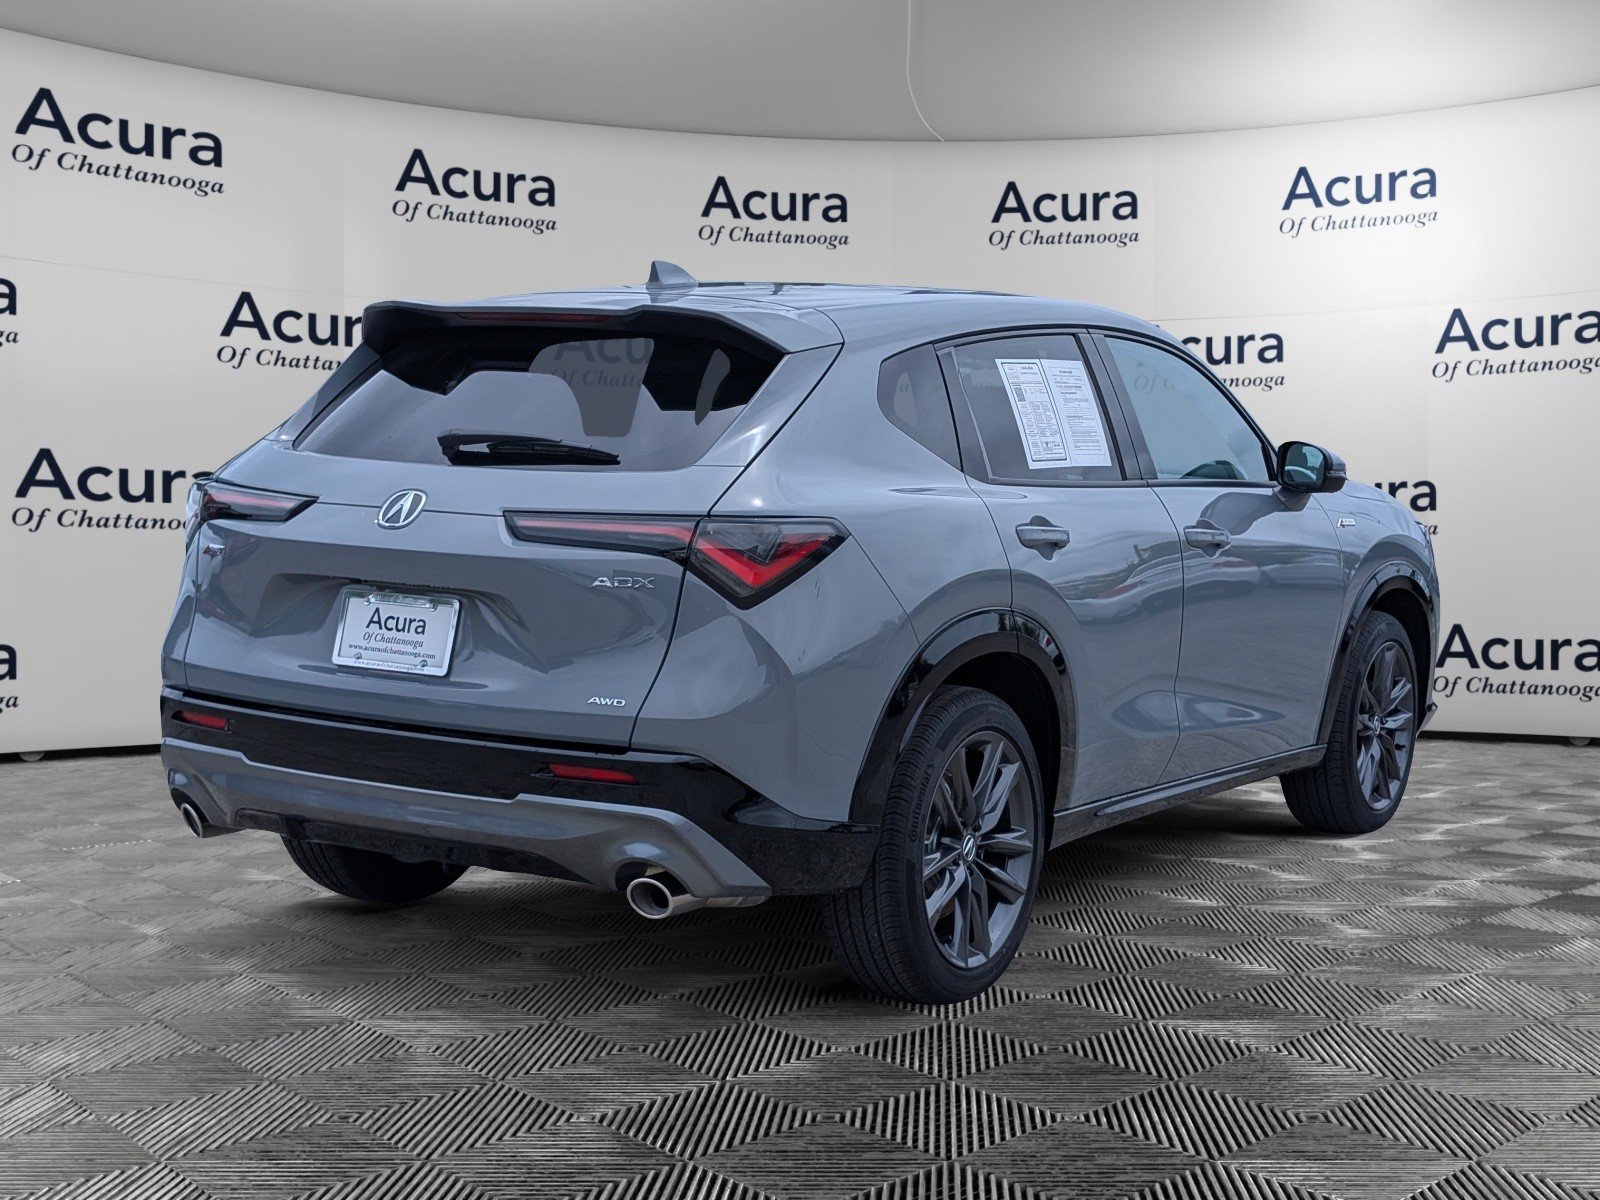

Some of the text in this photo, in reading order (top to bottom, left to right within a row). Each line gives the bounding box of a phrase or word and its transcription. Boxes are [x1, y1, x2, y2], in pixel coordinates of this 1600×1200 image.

[15, 87, 222, 168] Acura
[12, 144, 224, 197] Of Chattanooga
[395, 148, 556, 207] Acura
[701, 176, 848, 224] Acura
[991, 181, 1138, 224] Acura
[1282, 165, 1437, 212] Acura
[392, 199, 557, 235] Of Chattanooga
[1279, 211, 1438, 239] Of Chattanooga
[698, 224, 849, 250] Of Chattanooga
[989, 229, 1139, 250] Of Chattanooga
[220, 291, 363, 347] Acur
[1435, 308, 1600, 354] Acura
[216, 345, 341, 372] Of Chatta
[1182, 333, 1284, 365] ura
[1432, 361, 1462, 383] Of
[15, 448, 214, 503] Acur
[12, 507, 186, 532] Of Chattano
[590, 577, 654, 588] ADX
[365, 606, 427, 635] Acura
[348, 643, 436, 660] www.acuraofchattanooga.com
[363, 631, 424, 650] Of Chattanooga
[1436, 623, 1600, 672] Acura
[587, 696, 626, 707] AWD
[1433, 675, 1462, 698] Of
